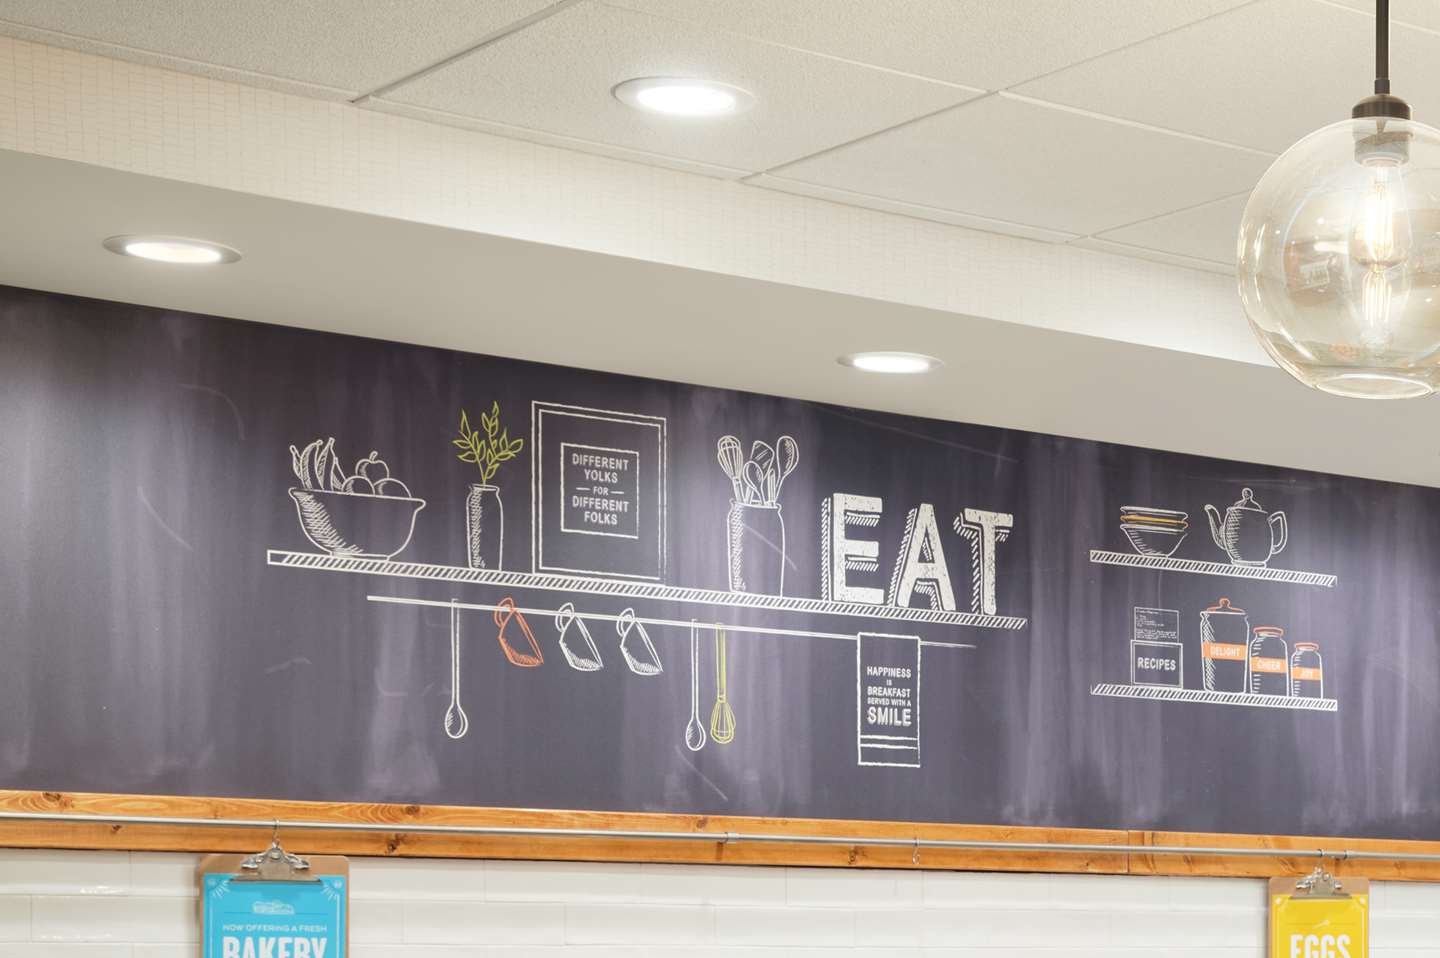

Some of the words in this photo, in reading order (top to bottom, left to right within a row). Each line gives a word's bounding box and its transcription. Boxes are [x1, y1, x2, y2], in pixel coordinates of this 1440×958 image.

[572, 453, 629, 471] DIFFERENT
[584, 468, 618, 484] YOLKS
[593, 486, 609, 496] FOR
[572, 495, 629, 513] DIFFERENT
[584, 511, 618, 526] FOLKS
[821, 492, 1014, 616] EAT
[1210, 646, 1240, 657] DELIGHT
[1137, 657, 1176, 671] RECIPES
[867, 666, 912, 679] HAPPINESS
[867, 686, 911, 698] BREAKFAST
[891, 699, 906, 707] WITH
[867, 706, 912, 727] SMILE
